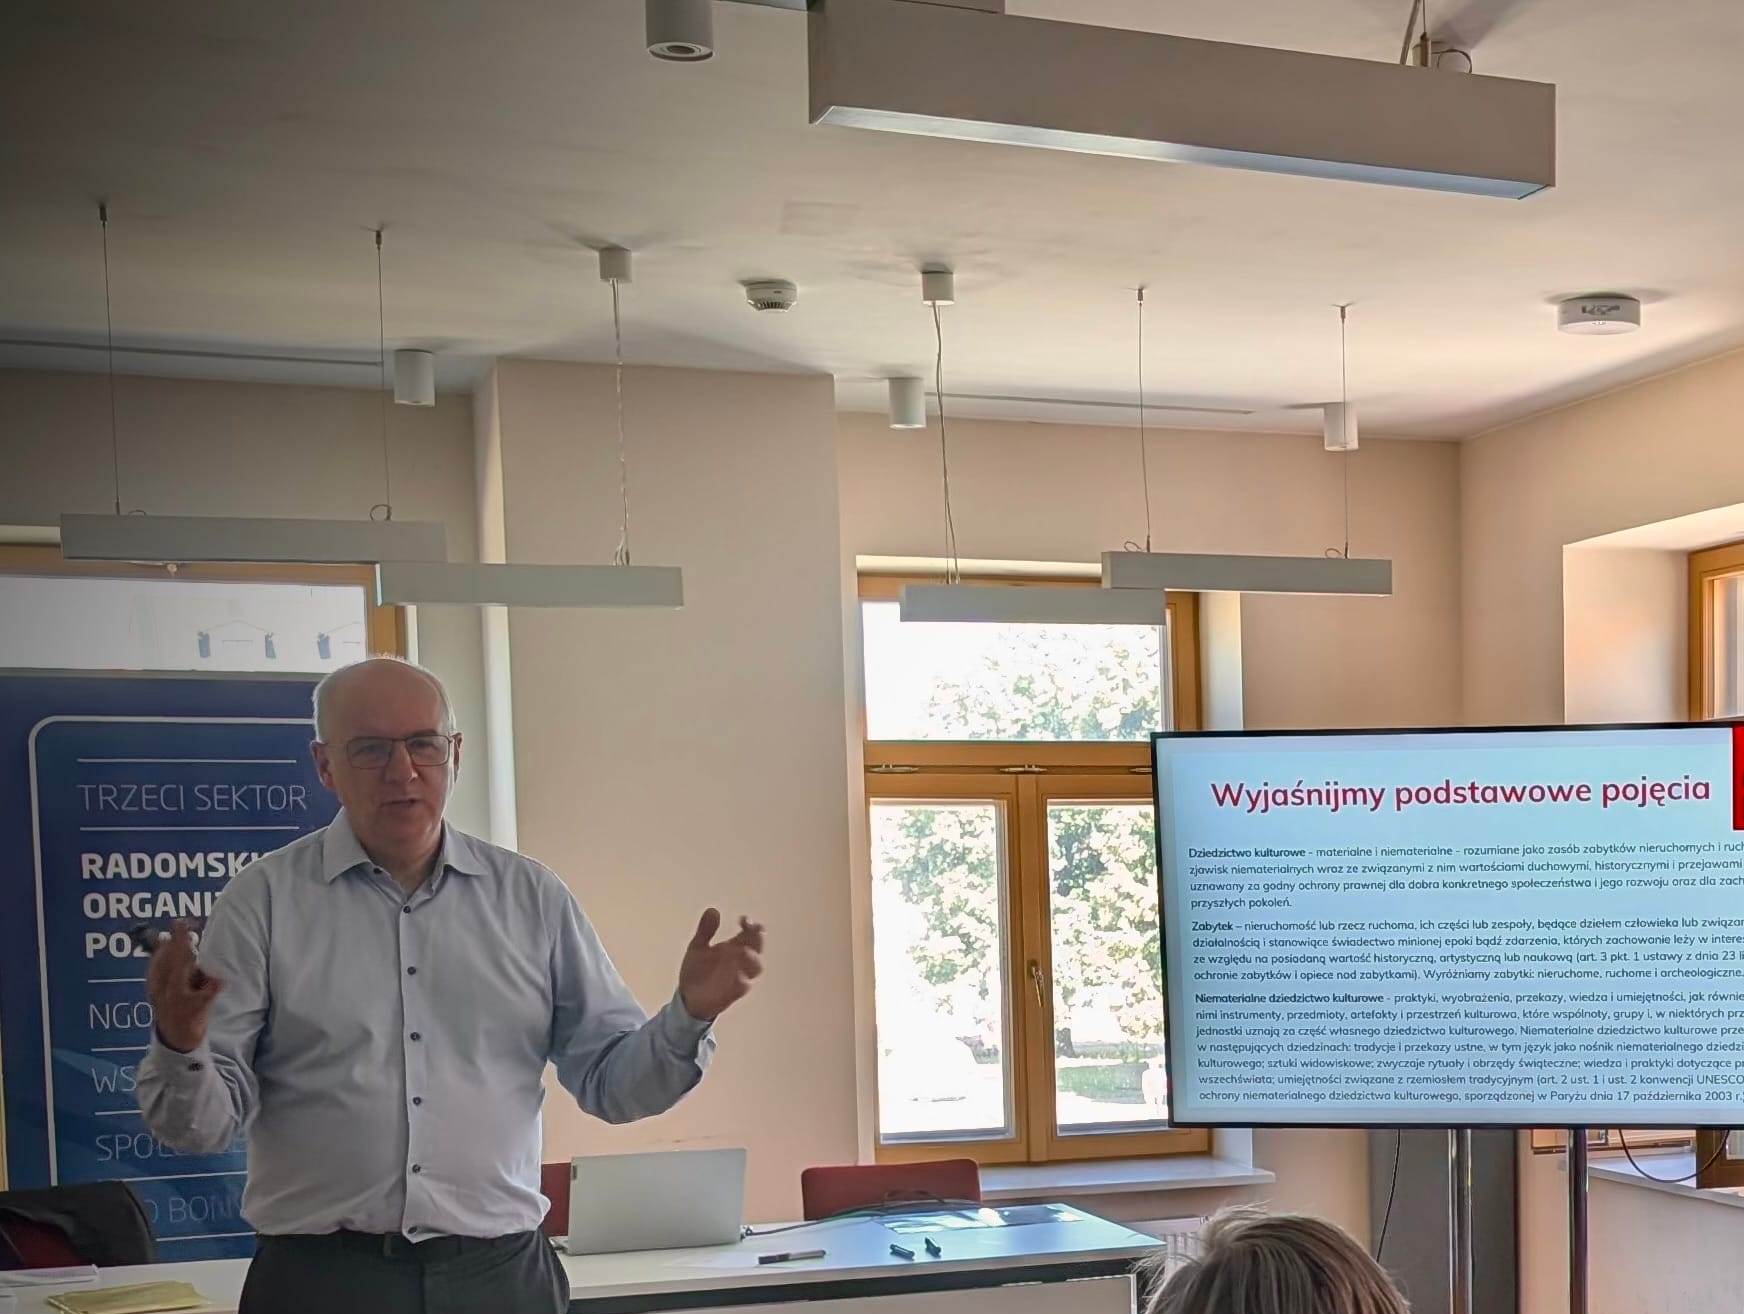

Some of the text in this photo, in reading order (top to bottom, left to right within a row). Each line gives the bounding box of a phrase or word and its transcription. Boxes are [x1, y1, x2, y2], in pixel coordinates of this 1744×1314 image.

[77, 785, 307, 811] TRZECI SEKTOR
[1211, 775, 1711, 813] Wyjaśnijmy podstawowe pojęcia
[1254, 846, 1306, 857] kulturowe
[1463, 844, 1519, 855] rozumiane
[81, 852, 268, 879] RADOMSK
[1189, 864, 1228, 876] zjawisk
[1190, 882, 1244, 893] uznawany
[1262, 880, 1295, 892] godny
[1298, 879, 1340, 892] ochrony
[1342, 879, 1386, 892] prawnej
[1407, 878, 1439, 889] dobra
[1625, 876, 1669, 889] rozwoju
[83, 891, 224, 919] ORGANI
[1191, 920, 1233, 933] Zabytek
[1397, 936, 1442, 948] minionej
[1444, 935, 1473, 948] epoki
[1642, 952, 1683, 963] ustawy
[1193, 969, 1238, 979] ochronie
[1605, 967, 1651, 978] ruchome
[1332, 992, 1384, 1002] kulturowe
[1568, 991, 1607, 1001] wiedza
[1350, 1008, 1397, 1021] artefakty
[1613, 1010, 1644, 1021] grupy
[1195, 1025, 1242, 1038] jednostki
[1663, 1024, 1717, 1034] kulturowe
[1353, 1041, 1395, 1054] tradycje
[1403, 1041, 1451, 1054] przekazy
[1267, 1057, 1297, 1068] sztuki
[1376, 1058, 1425, 1070] zwyczaje
[1583, 1057, 1622, 1067] wiedza
[1630, 1057, 1674, 1070] praktyki
[1639, 1073, 1693, 1086] konwencji
[1696, 1073, 1744, 1084] UNESCO
[1199, 1090, 1240, 1102] ochrony
[1704, 1090, 1732, 1100] 2003
